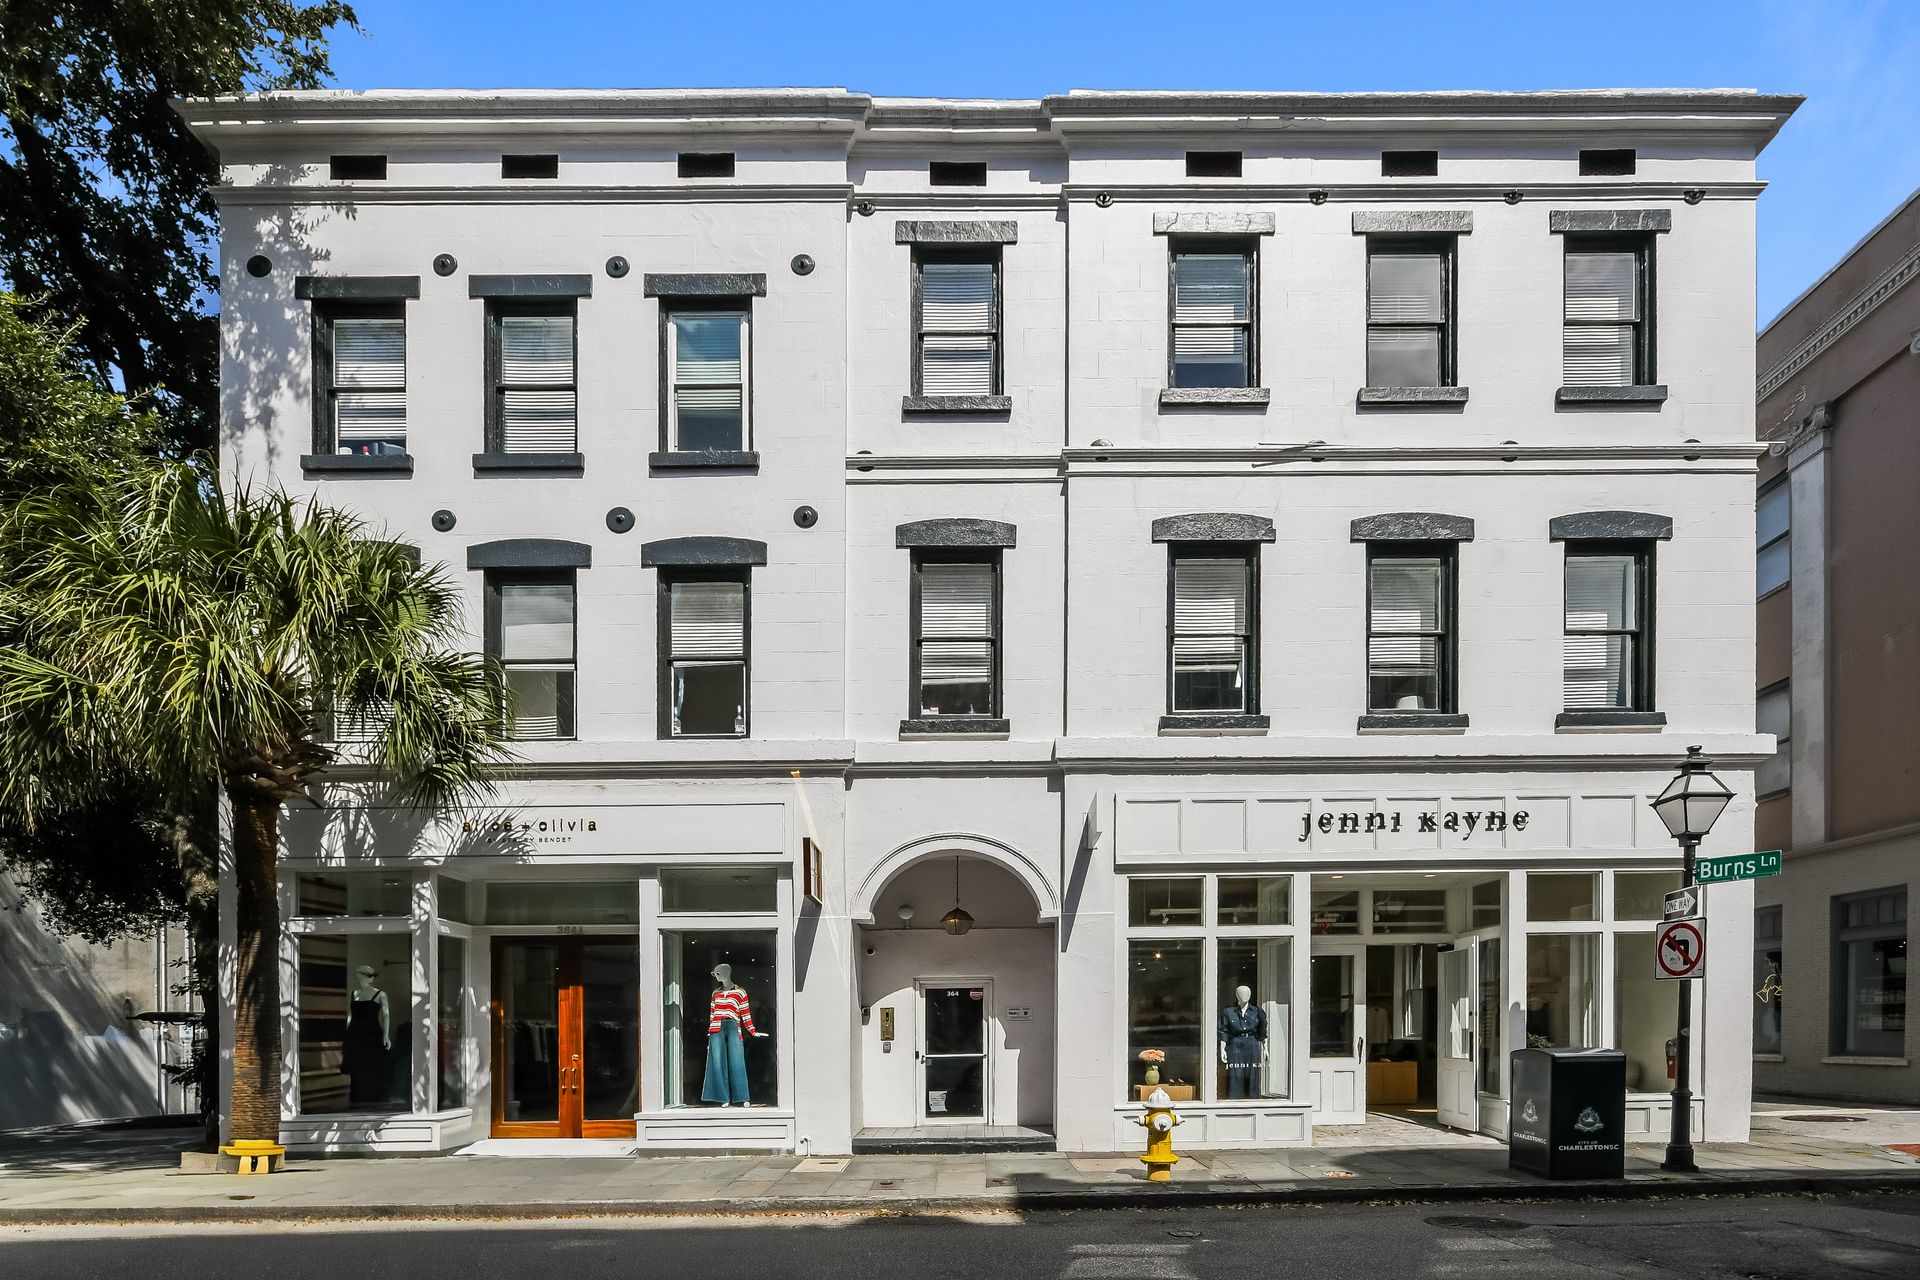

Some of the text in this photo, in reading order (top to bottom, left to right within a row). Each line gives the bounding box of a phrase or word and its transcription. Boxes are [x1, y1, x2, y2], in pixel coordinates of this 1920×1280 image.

[538, 818, 597, 832] olivia
[1298, 810, 1530, 842] jenni kayne
[1700, 856, 1777, 879] Burns Ln
[1666, 897, 1691, 913] ONE WAY
